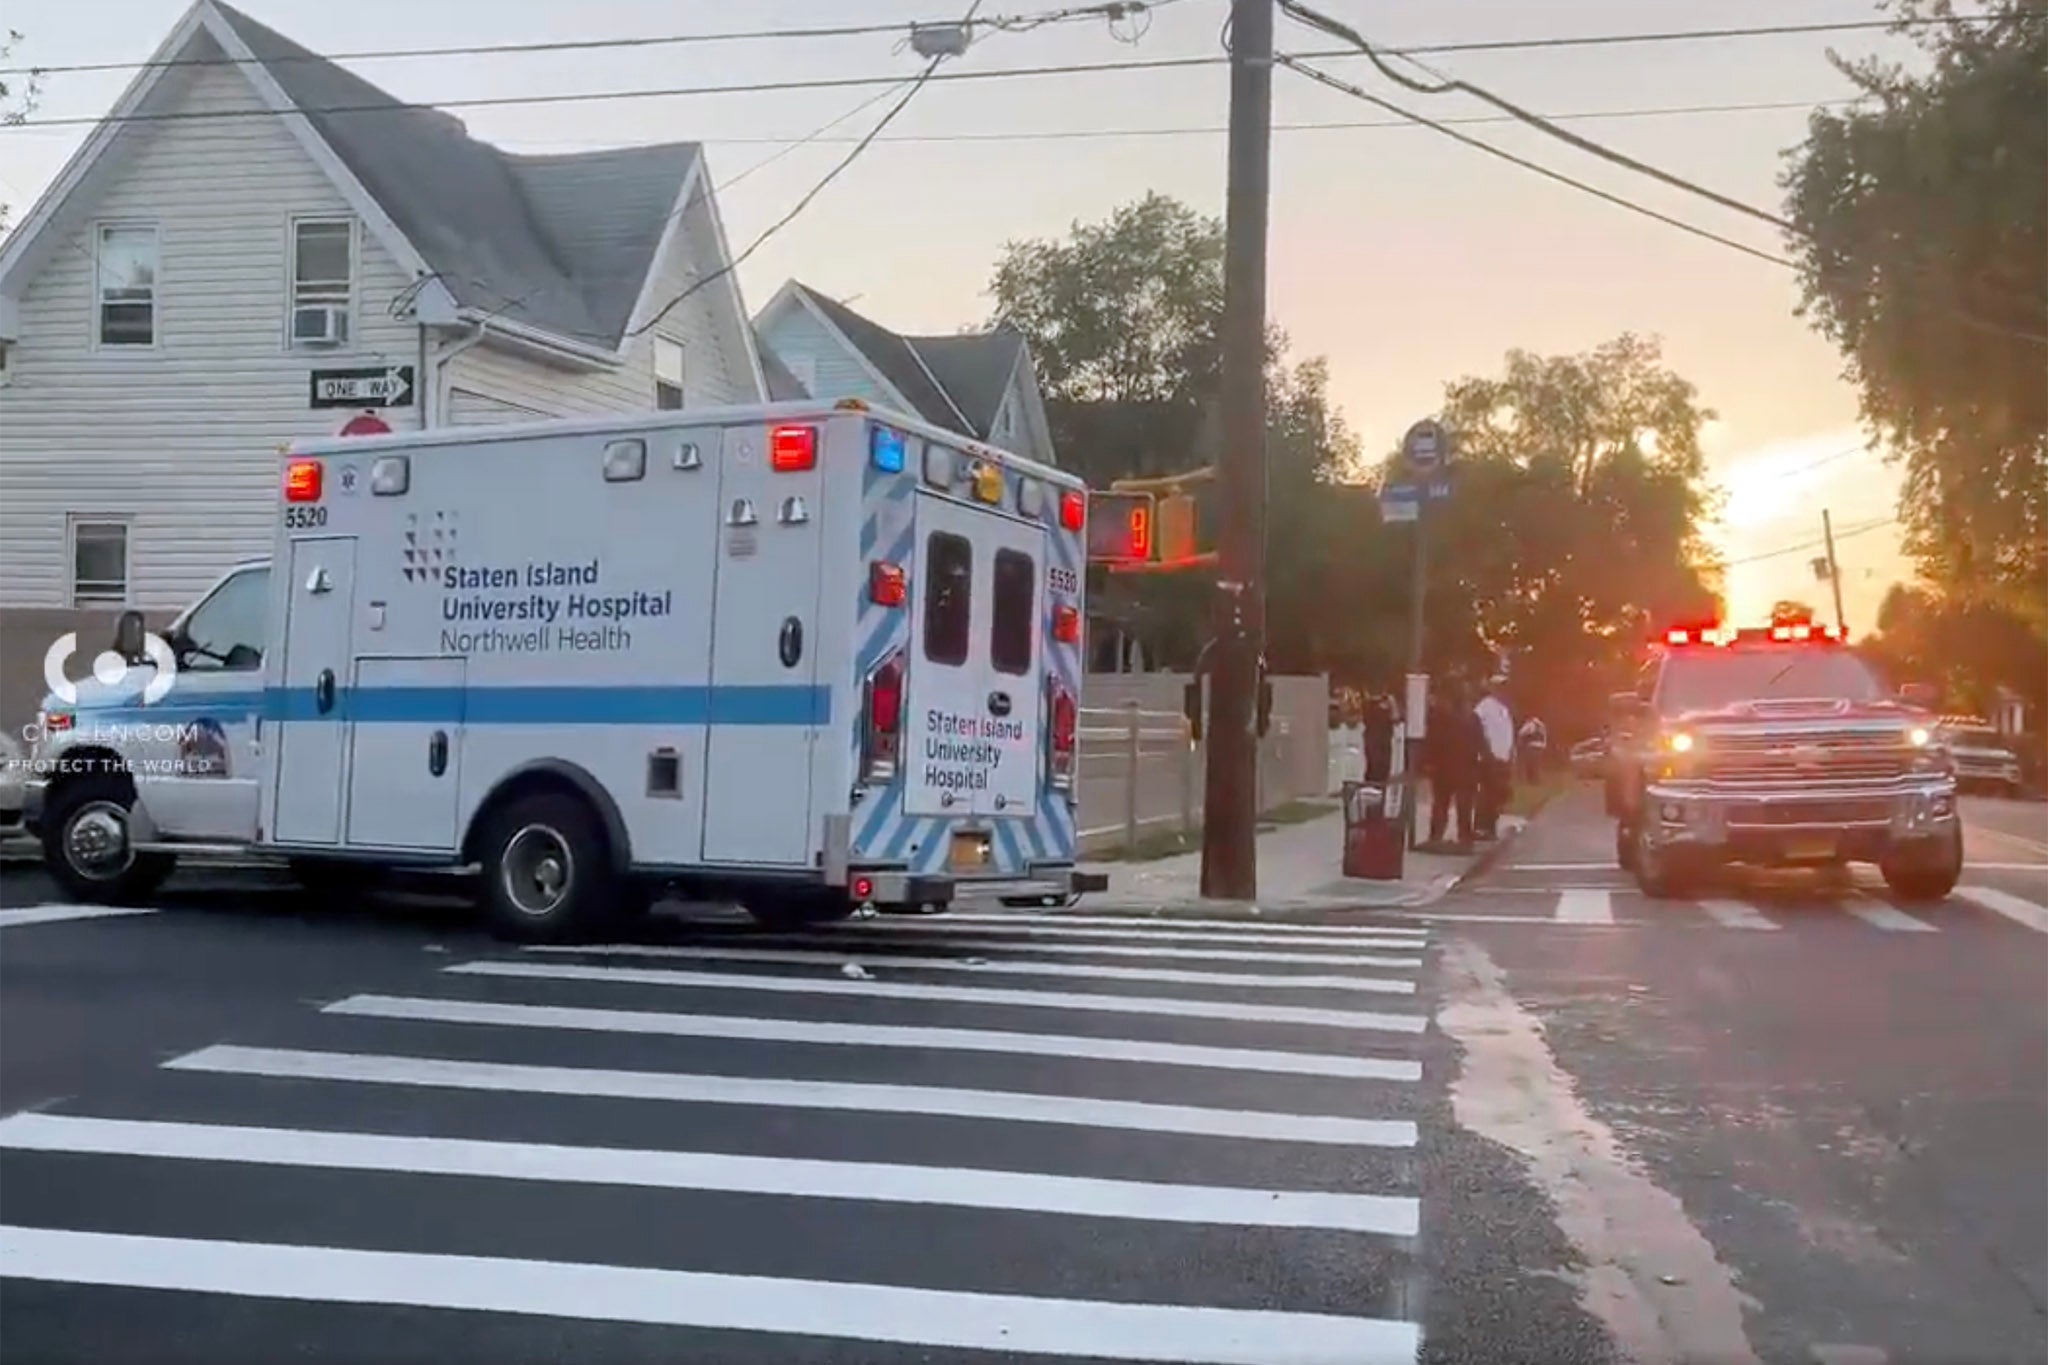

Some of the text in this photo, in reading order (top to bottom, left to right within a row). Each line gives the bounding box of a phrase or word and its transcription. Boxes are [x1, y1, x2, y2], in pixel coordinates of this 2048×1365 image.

[325, 379, 398, 397] ONE WAY
[286, 507, 327, 528] 5520
[1132, 508, 1146, 548] 9
[444, 558, 598, 589] Staten Island
[1050, 567, 1078, 593] 5520
[442, 590, 672, 622] University Hospital
[440, 624, 631, 652] Northwell Health
[927, 710, 1023, 740] Staten Island
[926, 738, 1001, 768] University
[925, 765, 988, 792] Hospital
